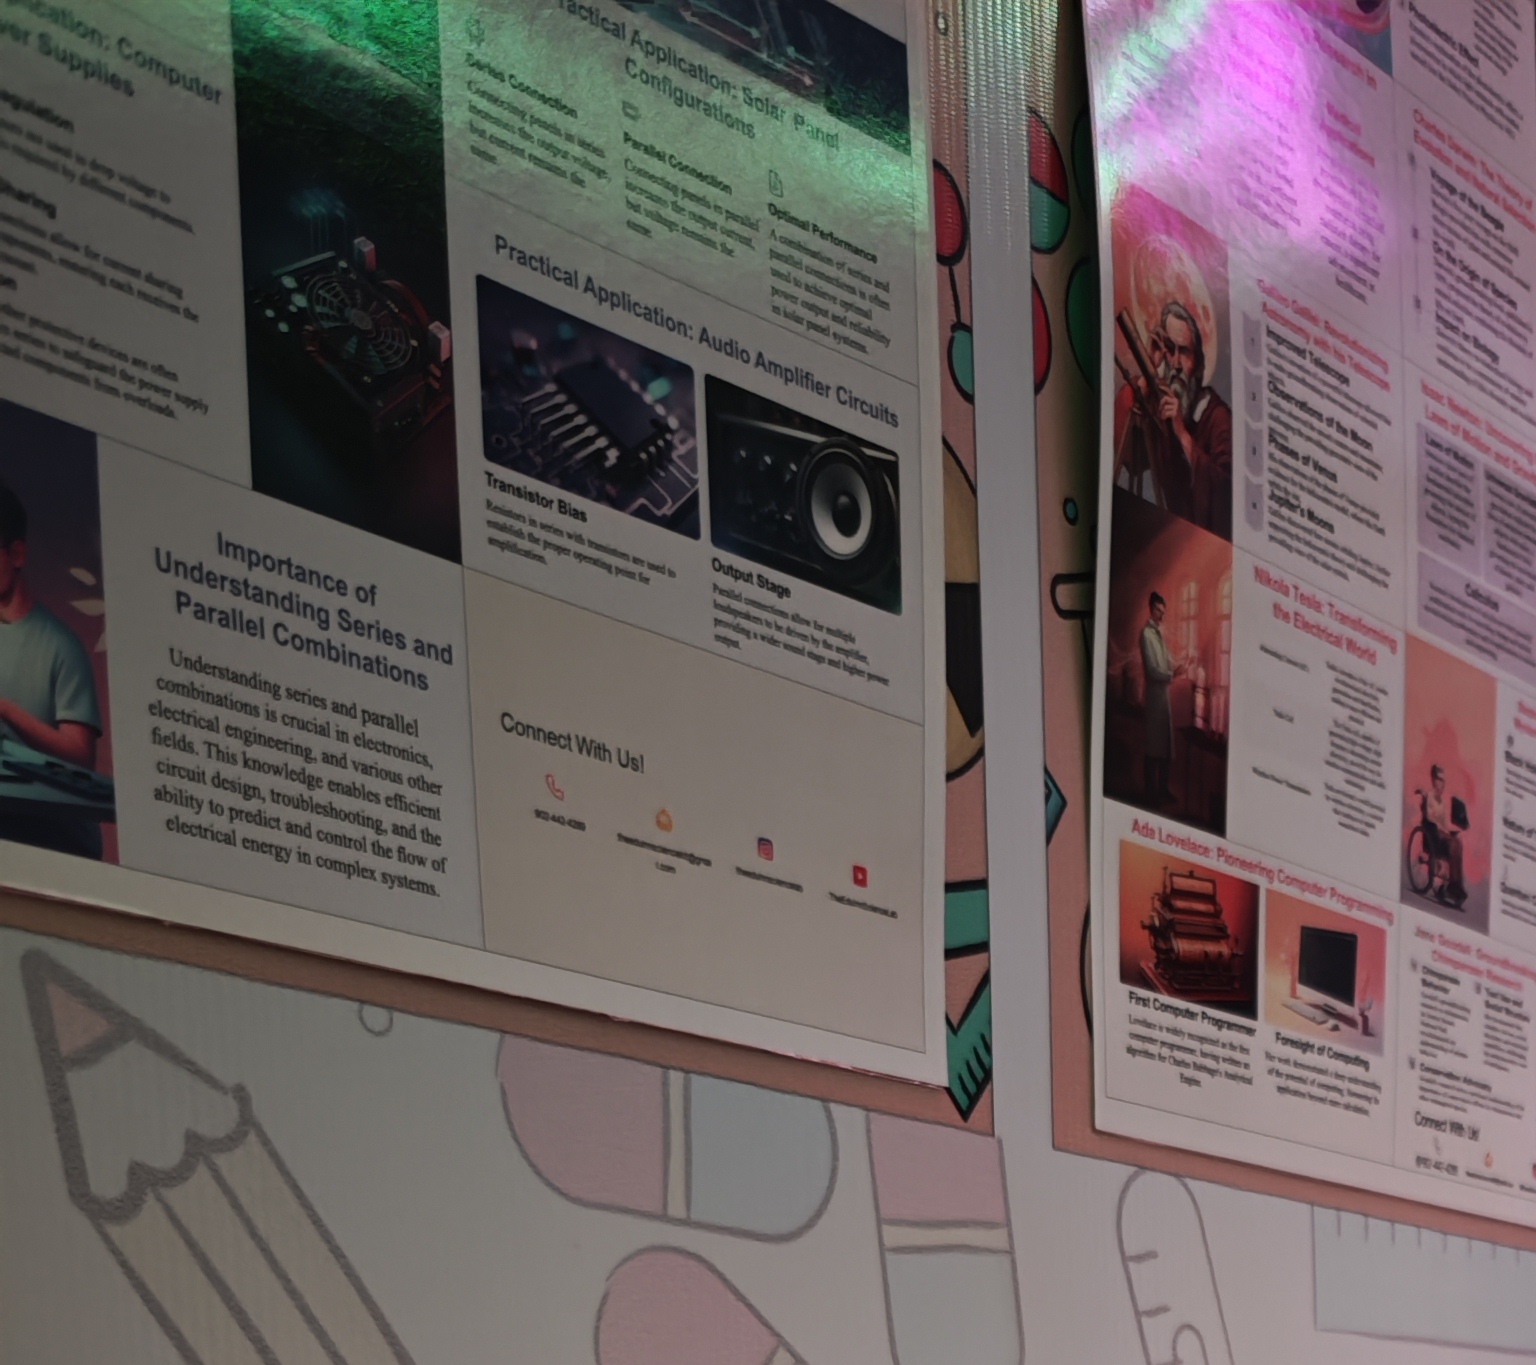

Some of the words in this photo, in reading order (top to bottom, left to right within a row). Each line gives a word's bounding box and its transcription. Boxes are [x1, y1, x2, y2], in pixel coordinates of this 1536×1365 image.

[117, 36, 222, 104] Computer
[624, 56, 756, 140] Configurations
[630, 29, 737, 99] Application:
[741, 85, 786, 122] Solar
[811, 223, 878, 265] Performance
[494, 233, 578, 291] Practical
[582, 274, 694, 341] Application:
[698, 325, 751, 365] Audio
[754, 350, 832, 400] Amplifier
[835, 384, 900, 429] Circuits
[484, 470, 555, 511] Transistor
[557, 498, 588, 523] Bias
[153, 546, 331, 632] Understanding
[337, 607, 407, 652] Series
[413, 636, 454, 666] and
[216, 531, 349, 598] Importance
[355, 583, 378, 607] of
[711, 557, 755, 585] Output
[756, 573, 792, 600] Stage
[174, 589, 266, 641] Parallel
[272, 621, 430, 692] Combinations
[155, 676, 261, 718] combinations
[264, 703, 278, 723] is
[280, 713, 331, 739] crucial
[334, 724, 350, 743] in
[352, 732, 434, 771] electronics,
[168, 647, 283, 701] Understanding
[284, 685, 328, 711] series
[331, 699, 358, 720] and
[360, 706, 419, 738] parallel
[147, 699, 220, 734] electrical
[224, 721, 318, 765] engineering,
[321, 750, 349, 770] and
[351, 758, 404, 786] various
[407, 774, 443, 796] other
[150, 725, 200, 757] fields.
[202, 740, 239, 766] This
[242, 750, 325, 792] knowledge
[327, 777, 382, 805] enables
[384, 792, 443, 822] efficient
[500, 711, 574, 753] Connect
[575, 733, 613, 765] With
[617, 747, 646, 775] Us!
[153, 784, 205, 816] ability
[208, 798, 226, 818] to
[228, 804, 283, 832] predict
[284, 819, 312, 840] and
[316, 828, 368, 855] control
[371, 839, 394, 860] the
[396, 845, 429, 869] flow
[431, 856, 448, 875] of
[155, 757, 208, 786] circuit
[210, 771, 267, 804] design,
[269, 787, 388, 837] troubleshooting,
[391, 820, 418, 842] and
[420, 826, 443, 848] the
[165, 815, 238, 848] electrical
[241, 835, 293, 865] energy
[296, 845, 312, 866] in
[315, 854, 378, 882] complex
[380, 870, 442, 898] systems.
[1131, 817, 1156, 840] Ada
[1158, 827, 1214, 859] Lovelace:
[1216, 846, 1275, 885] Pioneering
[1128, 989, 1151, 1009] First
[1152, 997, 1200, 1024] Computer
[1201, 1011, 1258, 1038] Programmer
[1275, 1031, 1315, 1056] Foresight
[1316, 1044, 1326, 1057] of
[1327, 1047, 1371, 1074] Computing
